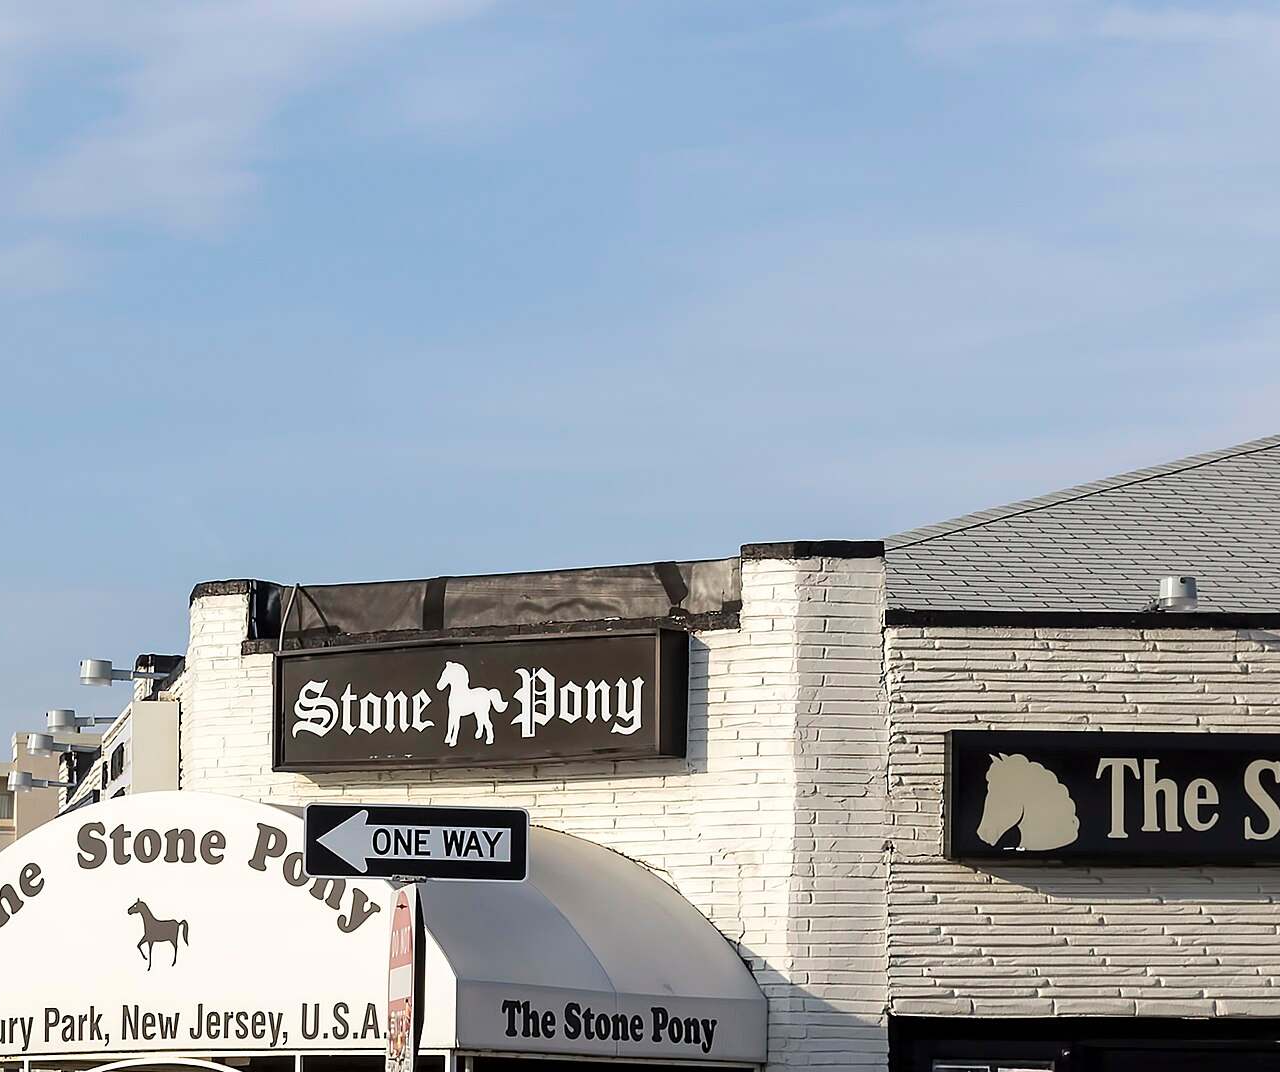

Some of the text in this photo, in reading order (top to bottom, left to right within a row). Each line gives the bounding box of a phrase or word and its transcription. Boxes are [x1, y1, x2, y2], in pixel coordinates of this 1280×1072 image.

[291, 666, 646, 738] Stone Pony
[1095, 757, 1220, 839] The
[372, 827, 504, 858] ONE WAY
[76, 821, 227, 870] Stone
[247, 821, 381, 934] Pony
[43, 1006, 111, 1047] Park,
[121, 1004, 180, 1040] New
[189, 1003, 288, 1047] Jersey,
[300, 1001, 387, 1041] U.S.A.
[501, 999, 718, 1054] The Stone Pony
